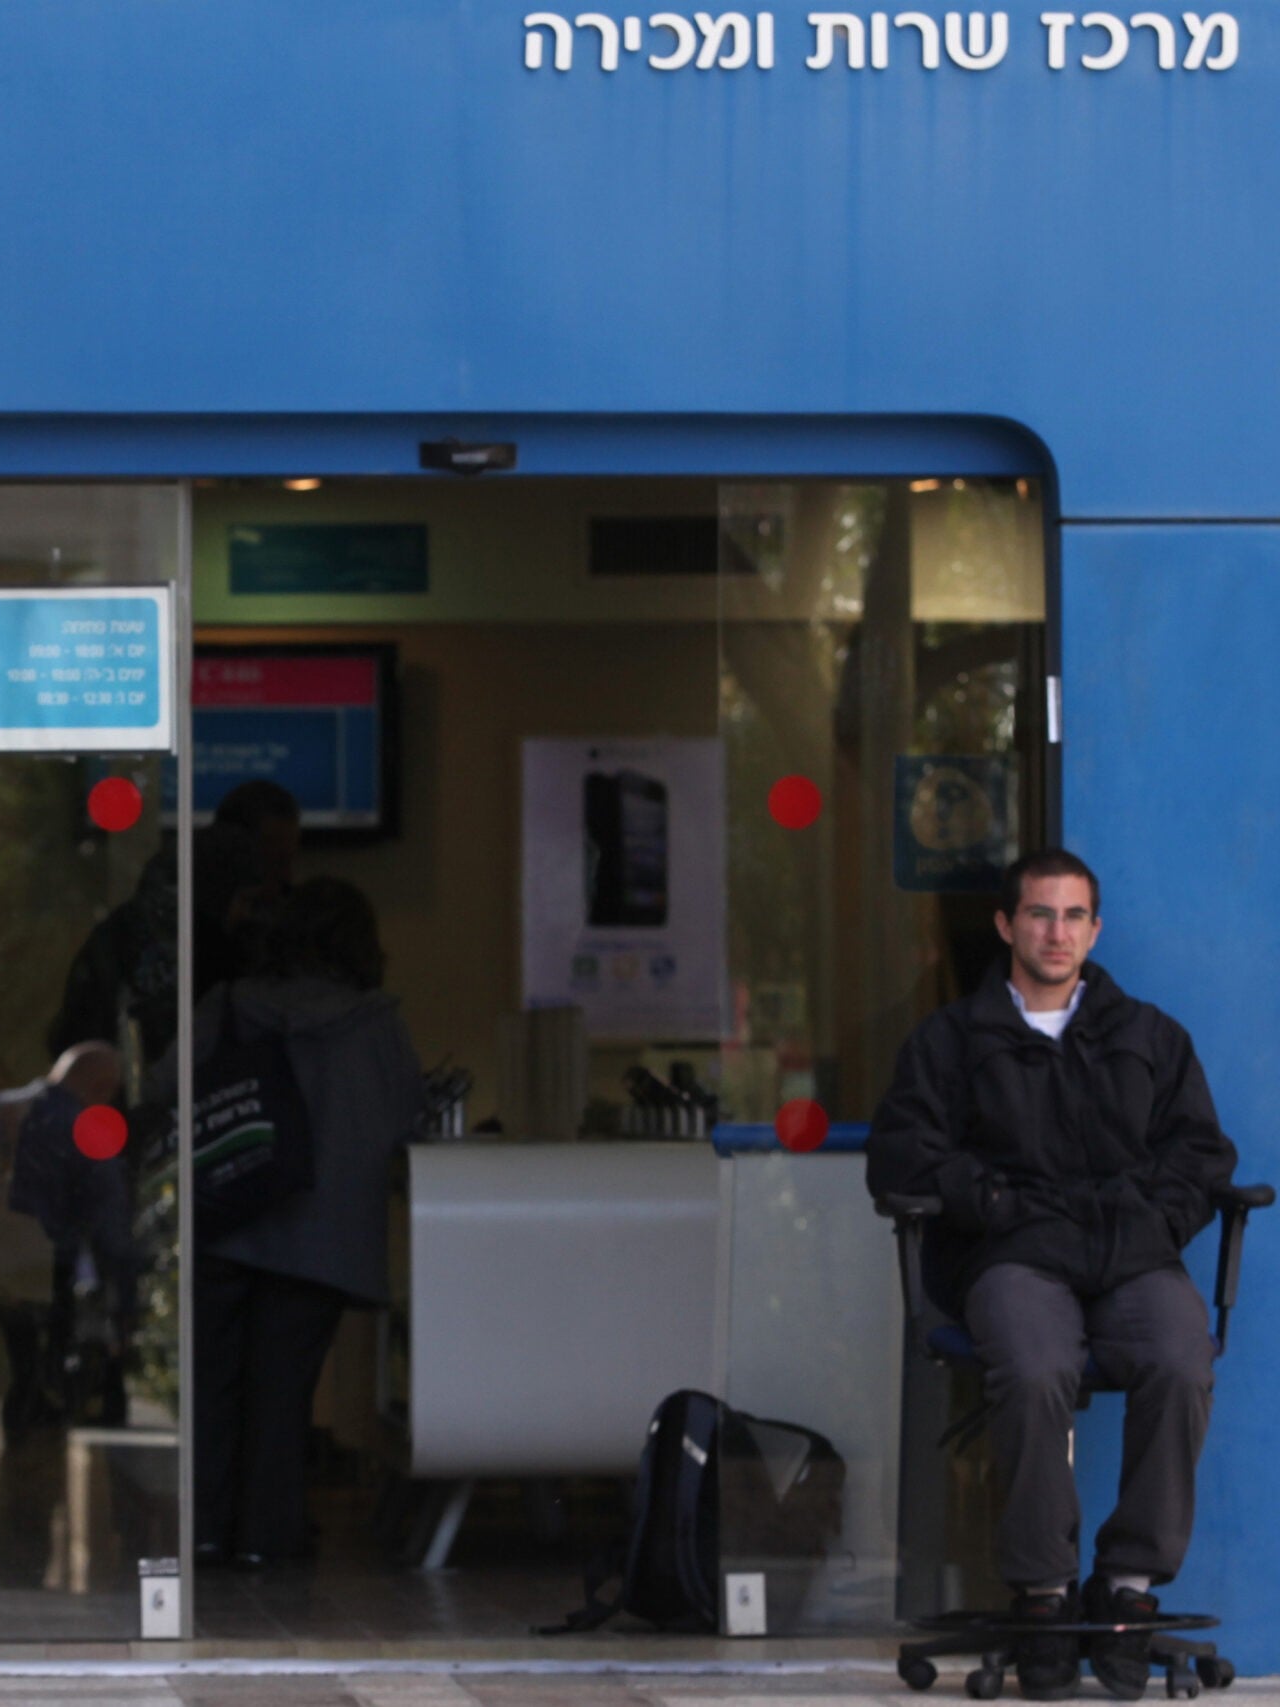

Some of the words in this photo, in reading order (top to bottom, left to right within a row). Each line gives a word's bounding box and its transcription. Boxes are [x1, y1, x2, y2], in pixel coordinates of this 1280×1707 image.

[524, 12, 774, 71] ומכירה
[806, 12, 1009, 70] שרות
[1041, 12, 1240, 70] מרכז
